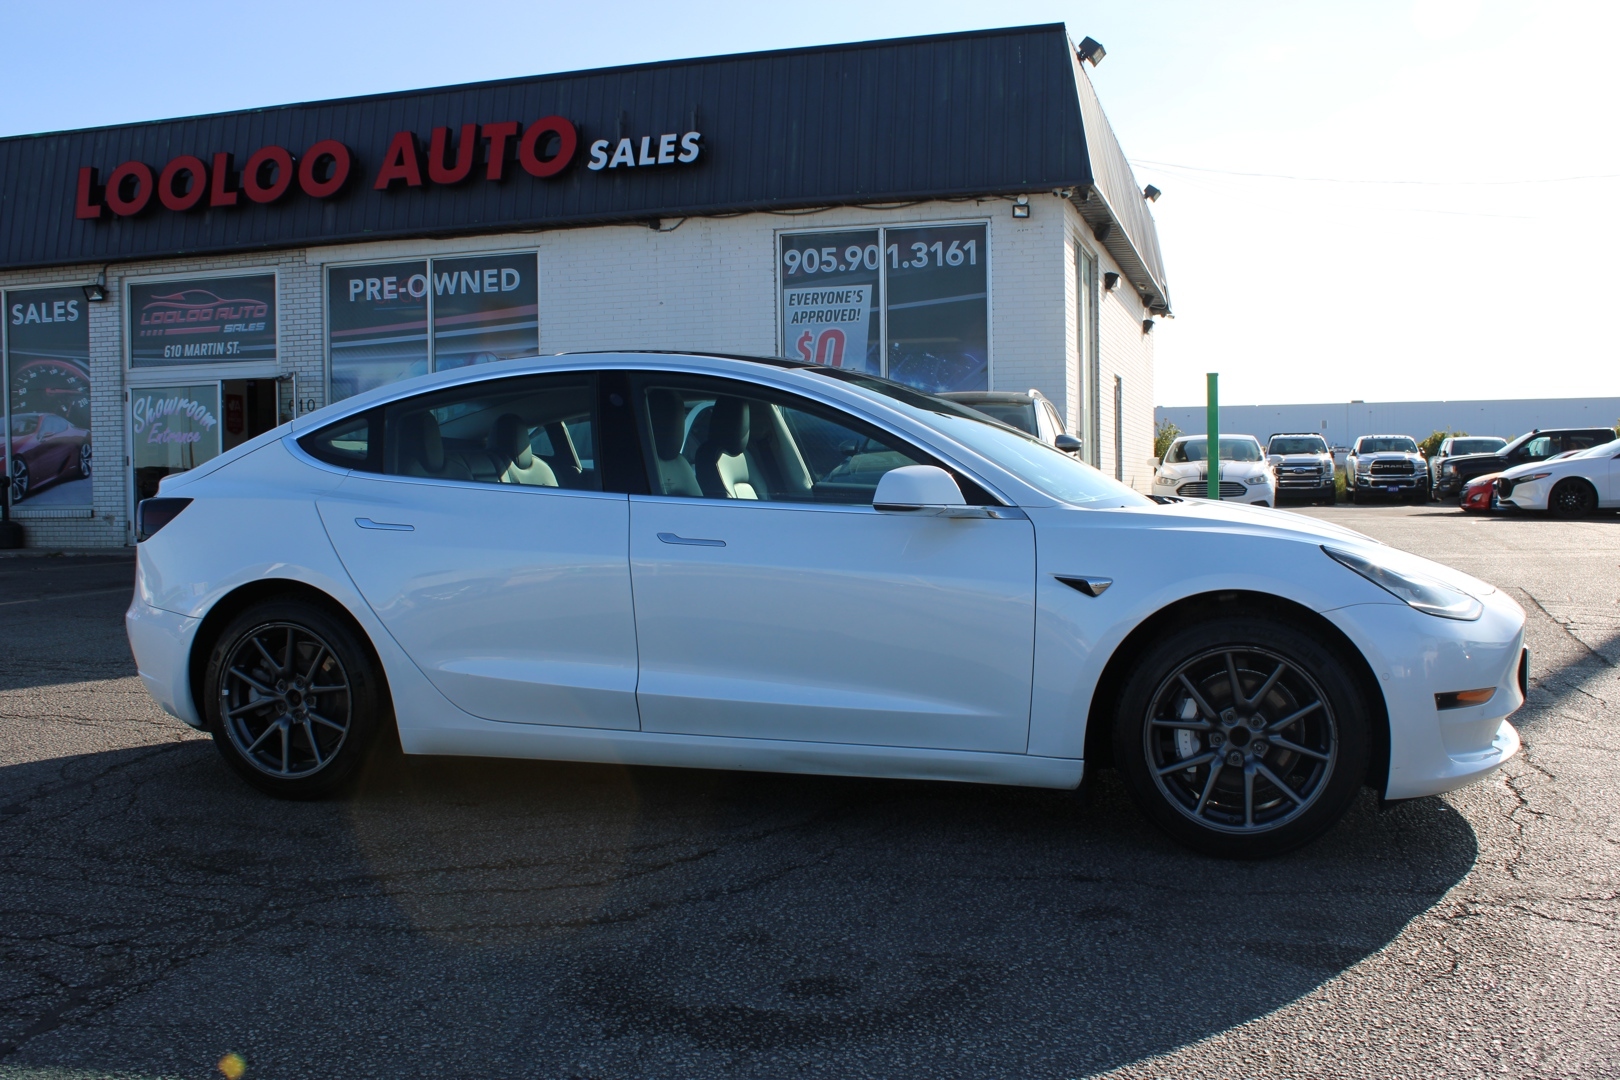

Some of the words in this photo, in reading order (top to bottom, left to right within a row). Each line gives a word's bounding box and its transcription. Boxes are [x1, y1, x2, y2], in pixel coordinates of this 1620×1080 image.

[76, 139, 351, 219] LOOLOO
[373, 115, 578, 190] AUTO
[587, 131, 702, 171] SALES
[783, 240, 977, 275] 905.901.3161
[349, 268, 520, 302] PRE-OWNED
[788, 289, 864, 307] EVERYONE'S
[11, 300, 79, 326] SALES
[140, 308, 213, 326] LOOLOO
[215, 304, 269, 321] AUTO
[790, 308, 861, 325] APPROVED!
[223, 322, 266, 333] SALES
[164, 343, 181, 358] 610
[184, 342, 224, 357] MARTIN
[226, 341, 240, 355] ST.
[133, 396, 217, 434] Showroom
[147, 423, 201, 444] Entrance
